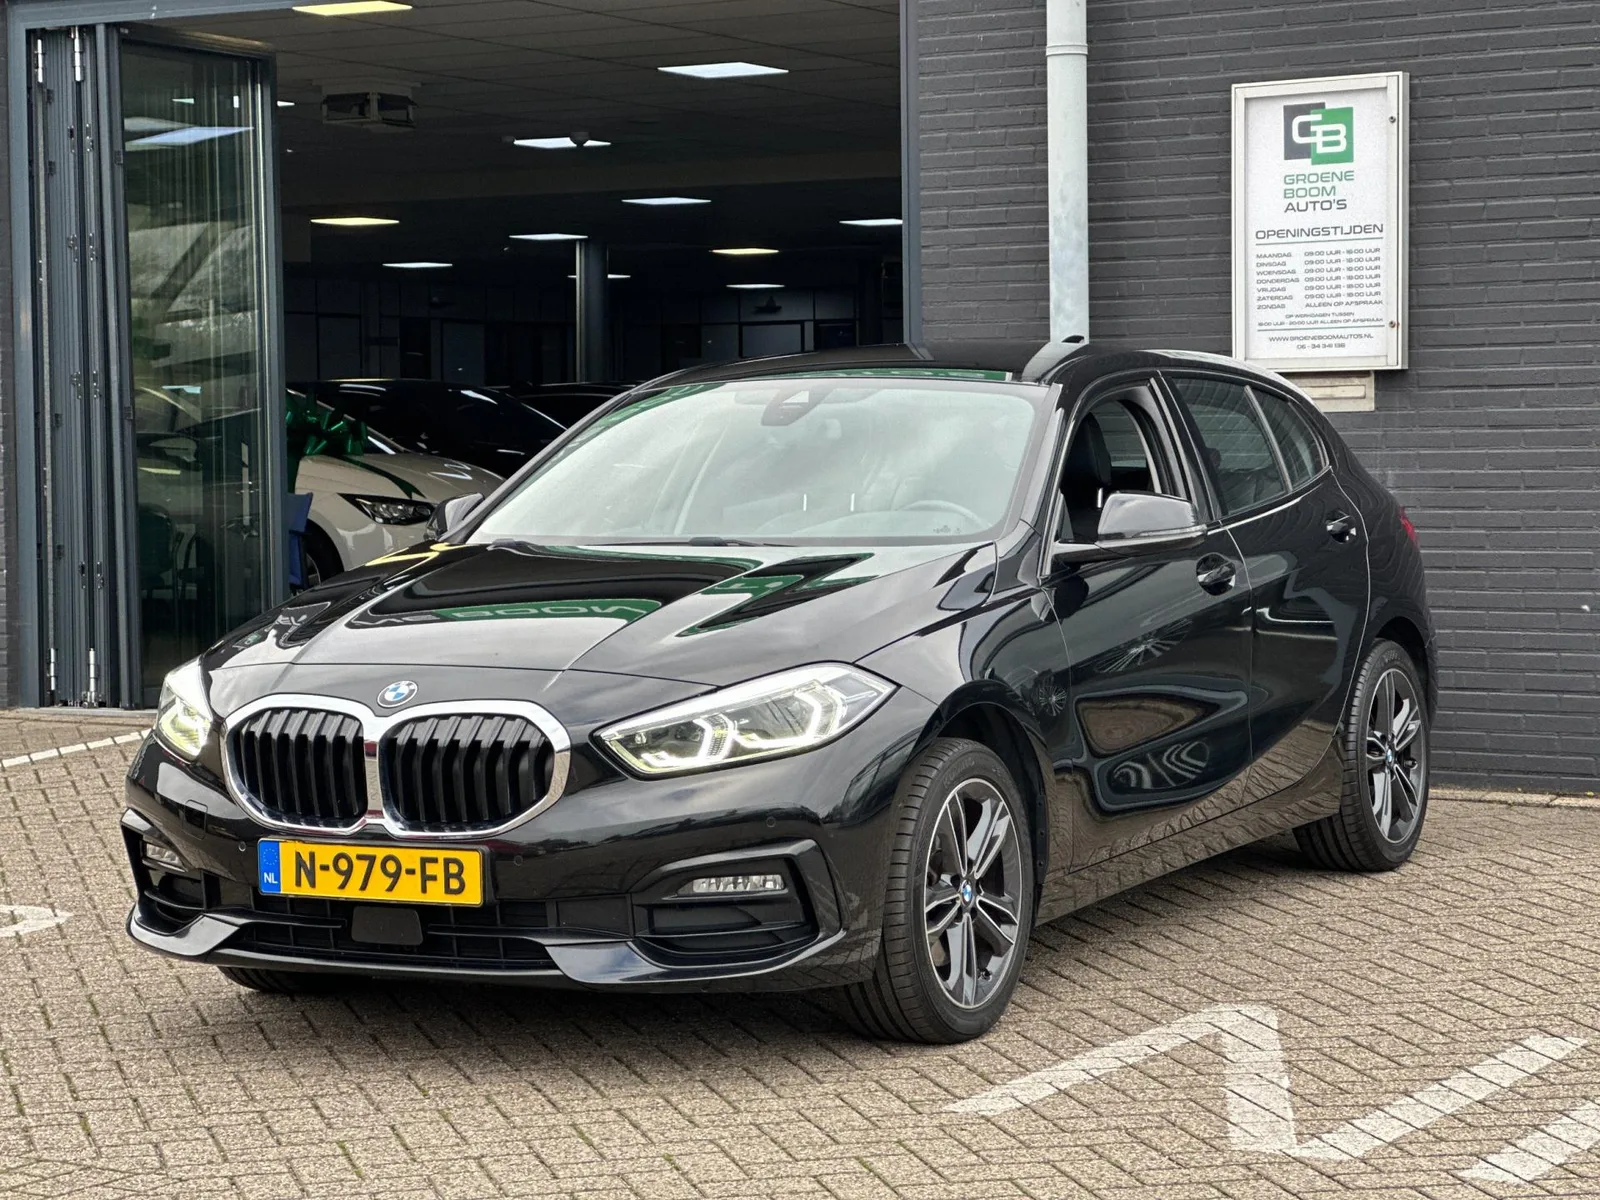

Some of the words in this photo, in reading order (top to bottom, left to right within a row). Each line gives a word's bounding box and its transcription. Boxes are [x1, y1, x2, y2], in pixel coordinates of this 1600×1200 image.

[1284, 171, 1354, 185] GROENE
[1284, 186, 1336, 199] BOOM
[1284, 199, 1347, 213] AUTO'S
[1255, 224, 1384, 239] OPENINGSTIJDEN
[264, 872, 278, 884] NL
[295, 851, 466, 895] N-979-FB
